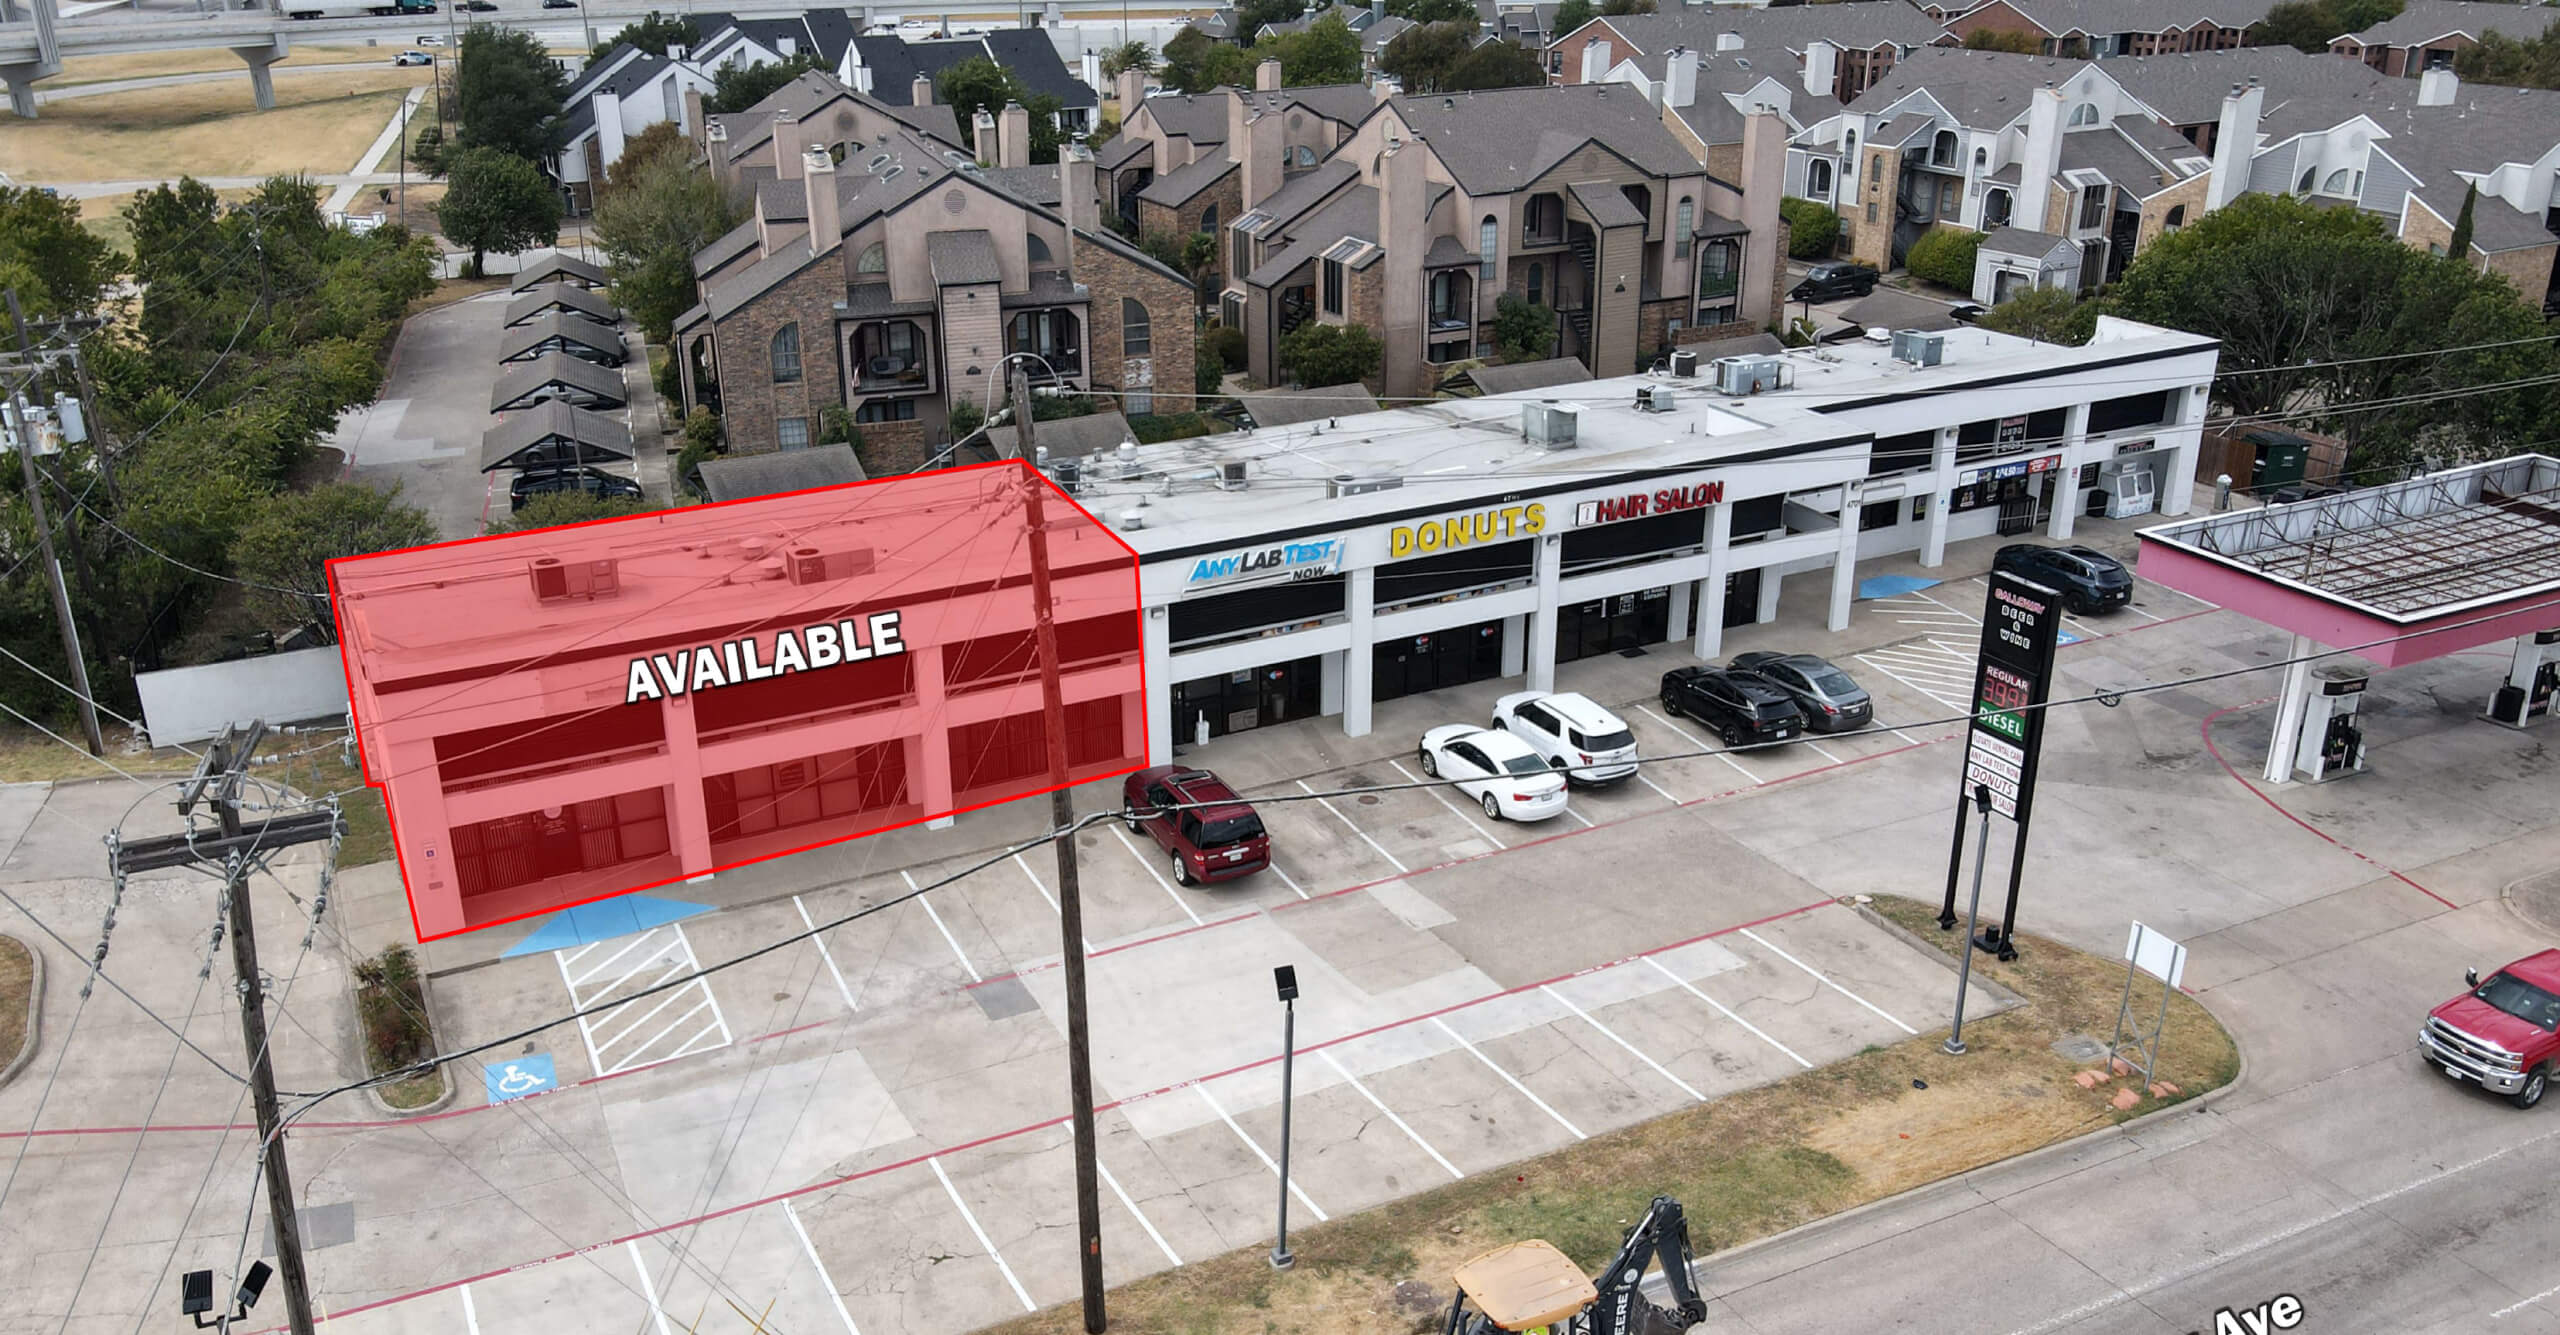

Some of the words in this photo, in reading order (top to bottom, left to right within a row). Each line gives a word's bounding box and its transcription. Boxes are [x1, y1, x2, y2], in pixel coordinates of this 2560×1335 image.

[1597, 493, 1649, 523] HAIR
[1654, 480, 1725, 515] SALON
[1391, 503, 1546, 558] DONUTS
[1292, 565, 1327, 581] NOW
[2001, 605, 2034, 626] BEER
[2000, 628, 2030, 649] WINE
[1986, 665, 2028, 691] REGULAR
[1979, 706, 2022, 737] DIESEL
[1971, 749, 1982, 760] ANY
[1983, 755, 1992, 767] LAB
[1972, 767, 2014, 796] DONUTS
[1614, 1293, 1628, 1335] EERE
